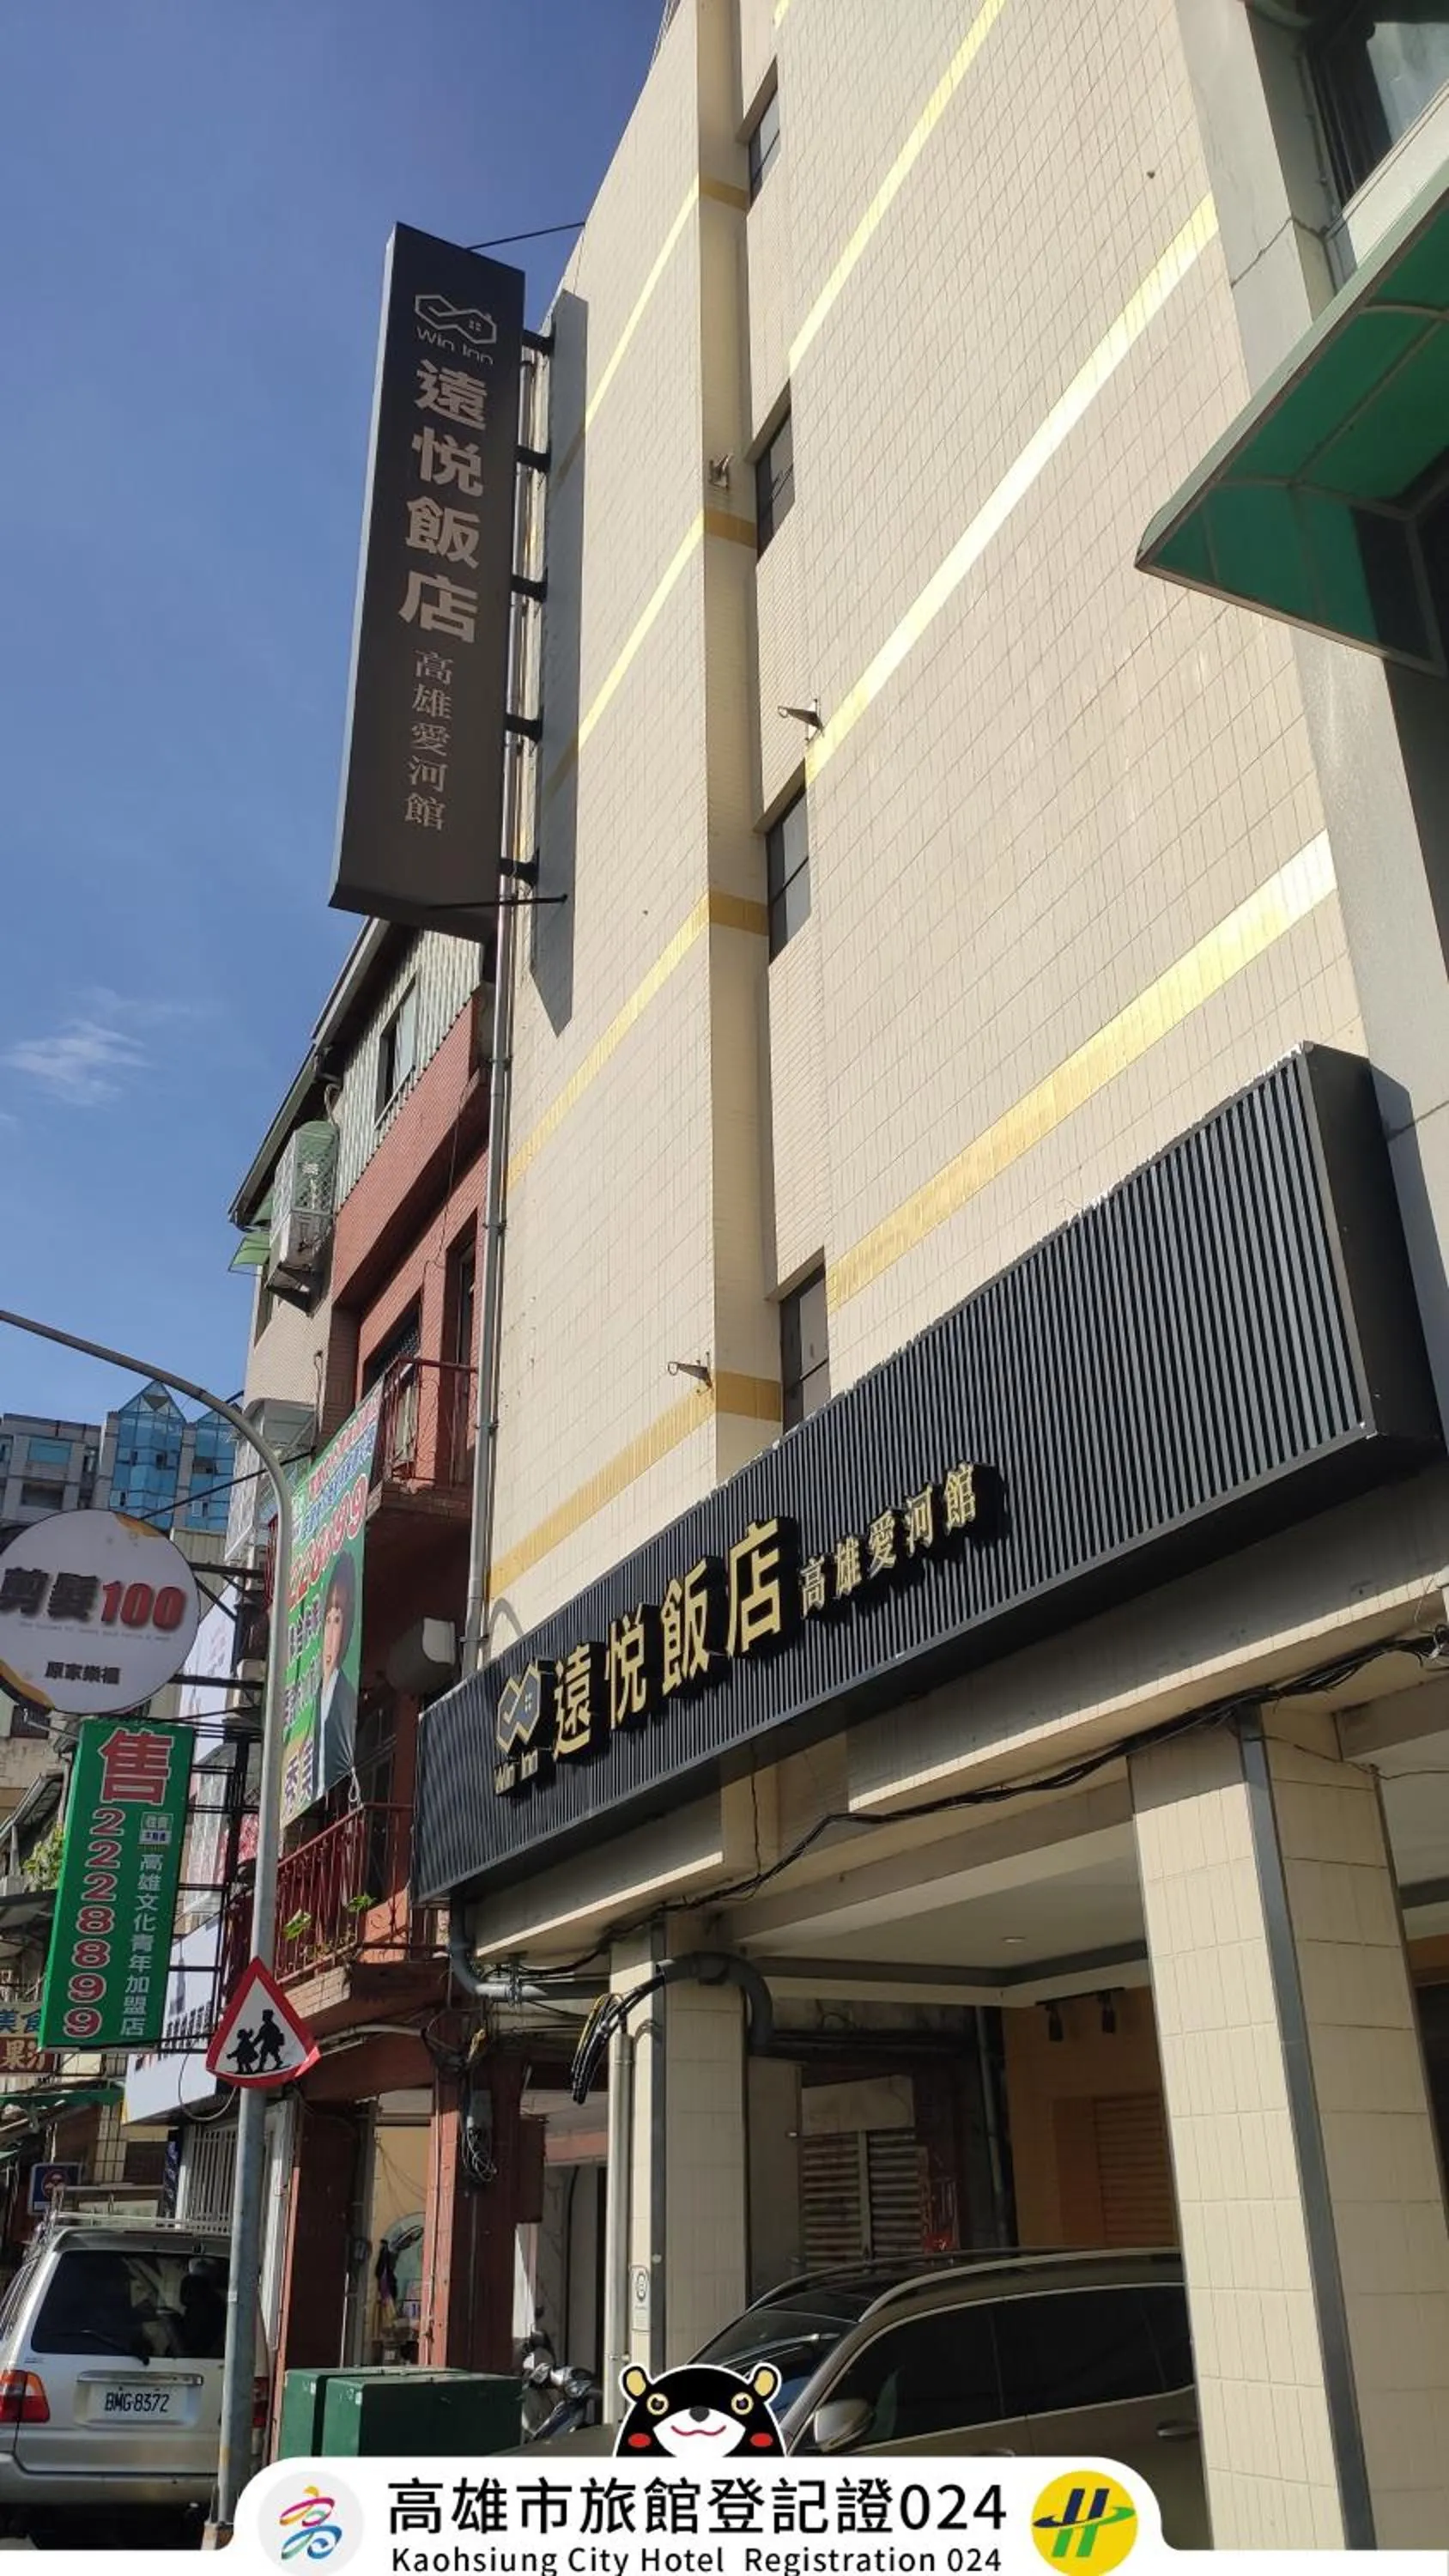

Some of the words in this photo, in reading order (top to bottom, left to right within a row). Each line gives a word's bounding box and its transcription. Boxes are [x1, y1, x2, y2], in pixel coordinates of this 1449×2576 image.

[415, 325, 454, 352] Win
[404, 649, 454, 830] 高雄愛河館
[799, 1461, 977, 1619] 高雄愛河館
[98, 1727, 175, 1807] 售
[64, 1807, 126, 2038] 2228899
[120, 1853, 164, 2037] 高雄文化青年加盟店
